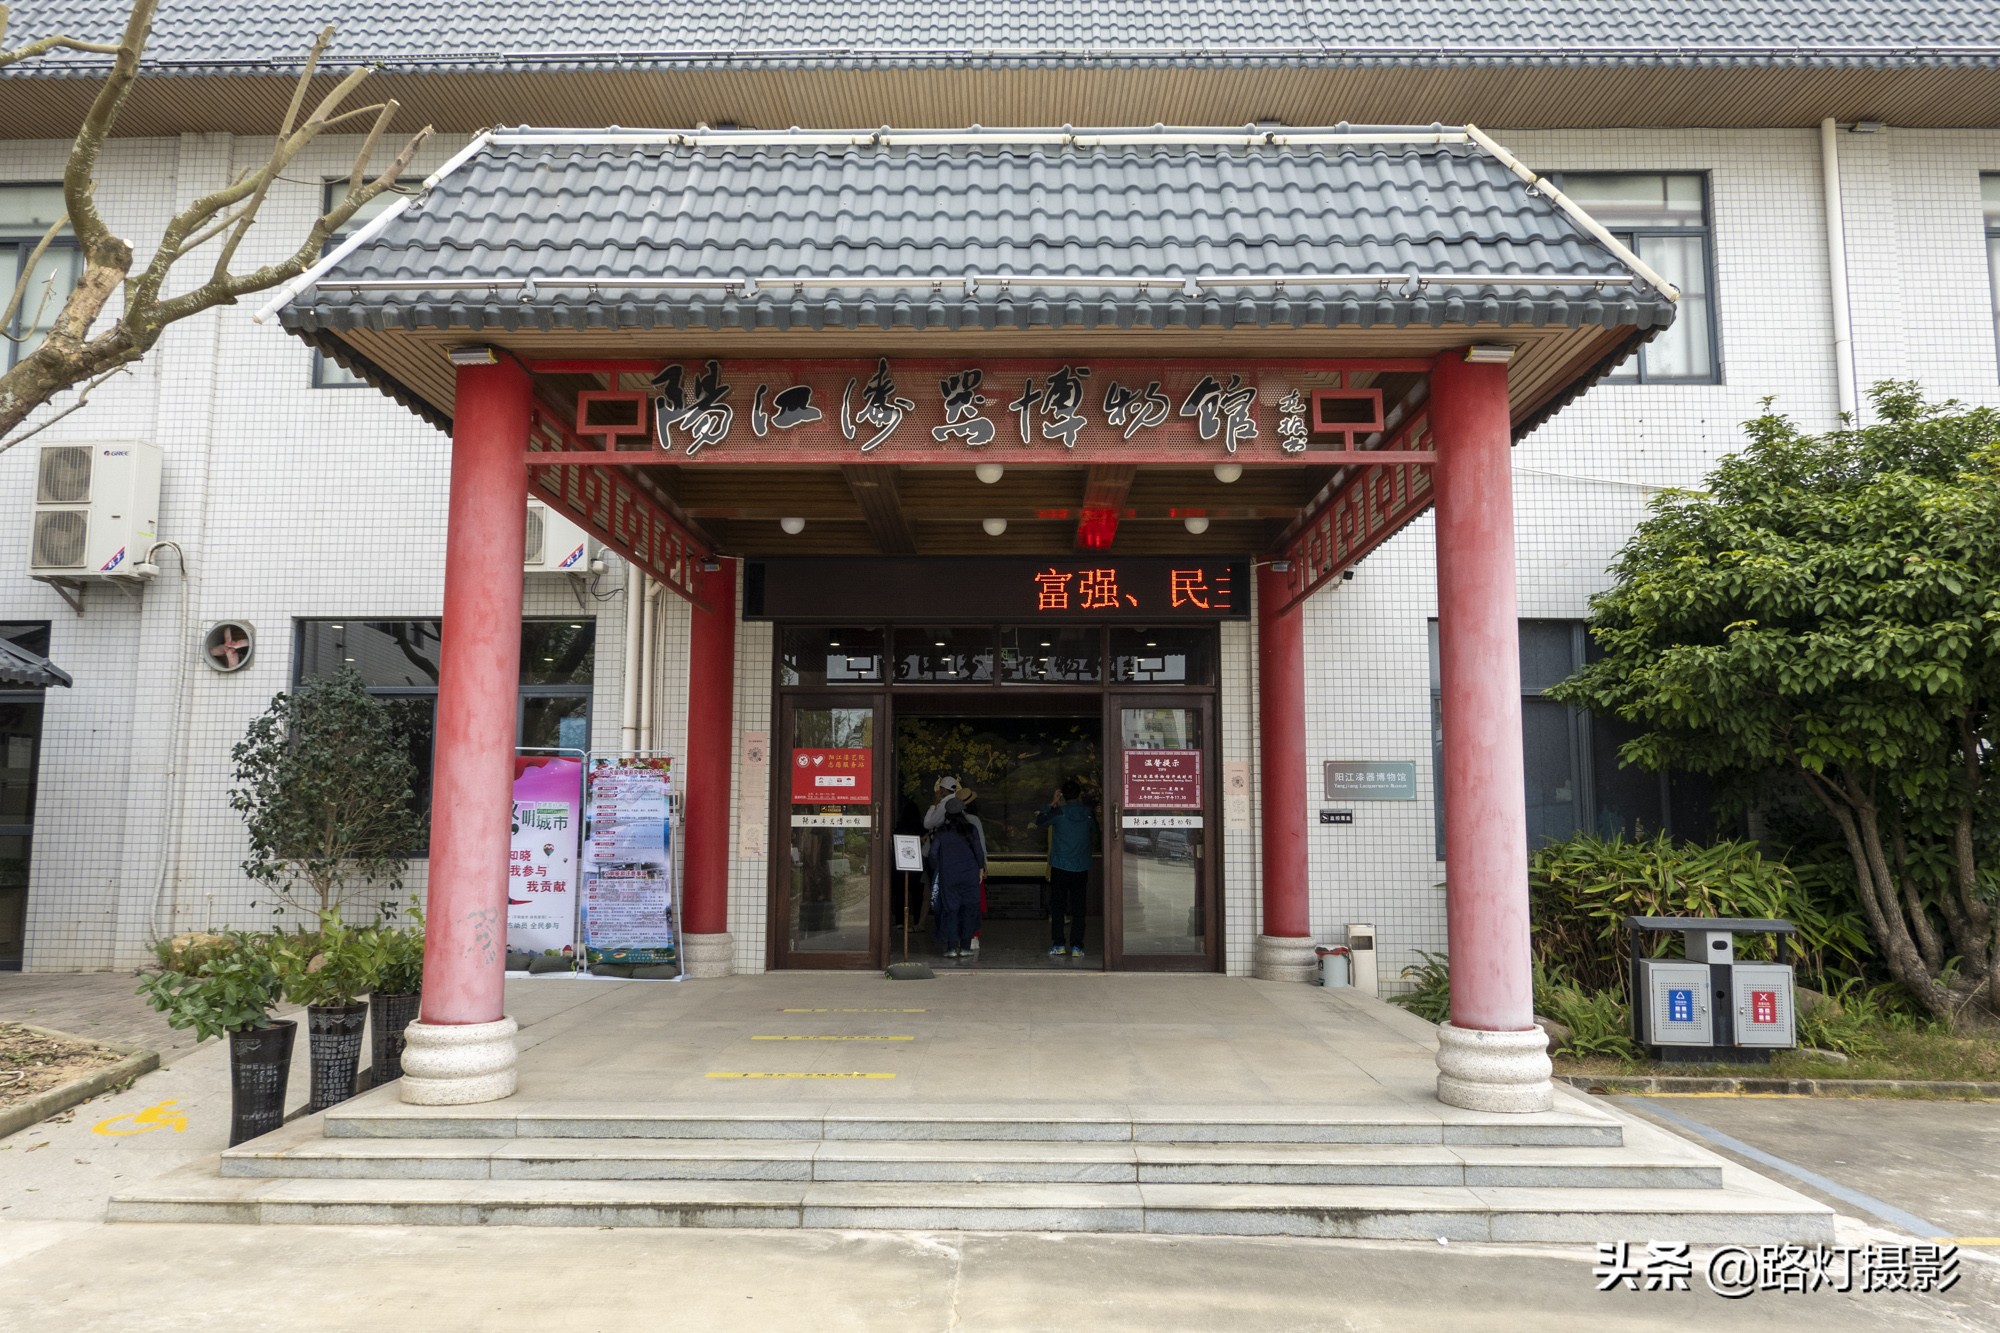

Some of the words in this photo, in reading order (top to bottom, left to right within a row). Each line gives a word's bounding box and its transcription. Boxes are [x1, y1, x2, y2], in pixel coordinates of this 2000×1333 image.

[1144, 758, 1180, 767] 温馨提示
[1334, 772, 1407, 782] 阳江漆器博物馆
[510, 865, 547, 877] 我参与
[526, 880, 567, 892] 我贡献
